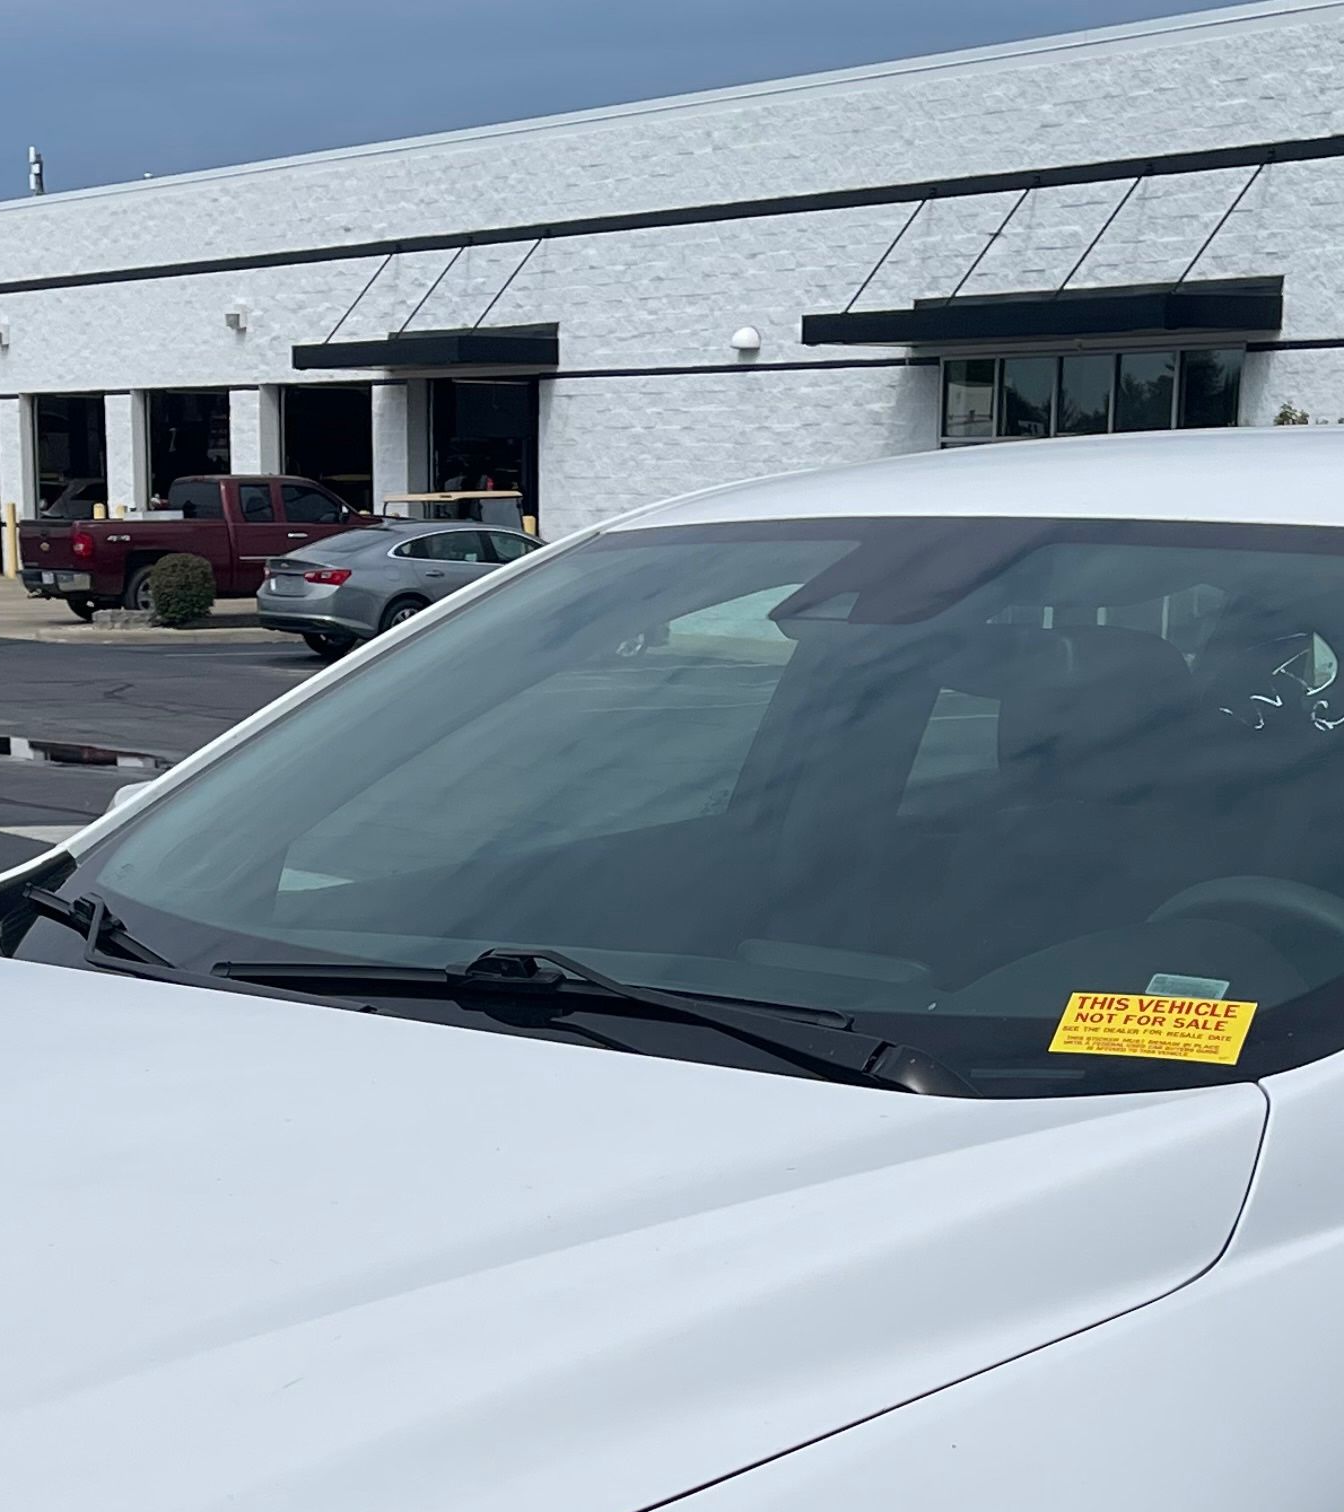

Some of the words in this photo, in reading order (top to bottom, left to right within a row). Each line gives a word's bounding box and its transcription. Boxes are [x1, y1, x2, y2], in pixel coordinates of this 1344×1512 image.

[1077, 996, 1130, 1012] THIS
[1138, 998, 1241, 1018] VEHICLE
[1073, 1012, 1118, 1025] NOT
[1123, 1014, 1166, 1028] FOR
[1173, 1018, 1228, 1032] SALE
[1103, 1027, 1139, 1035] DEALER
[1143, 1028, 1163, 1036] FOR
[1166, 1031, 1204, 1040] RESALE
[1208, 1034, 1233, 1042] DATE
